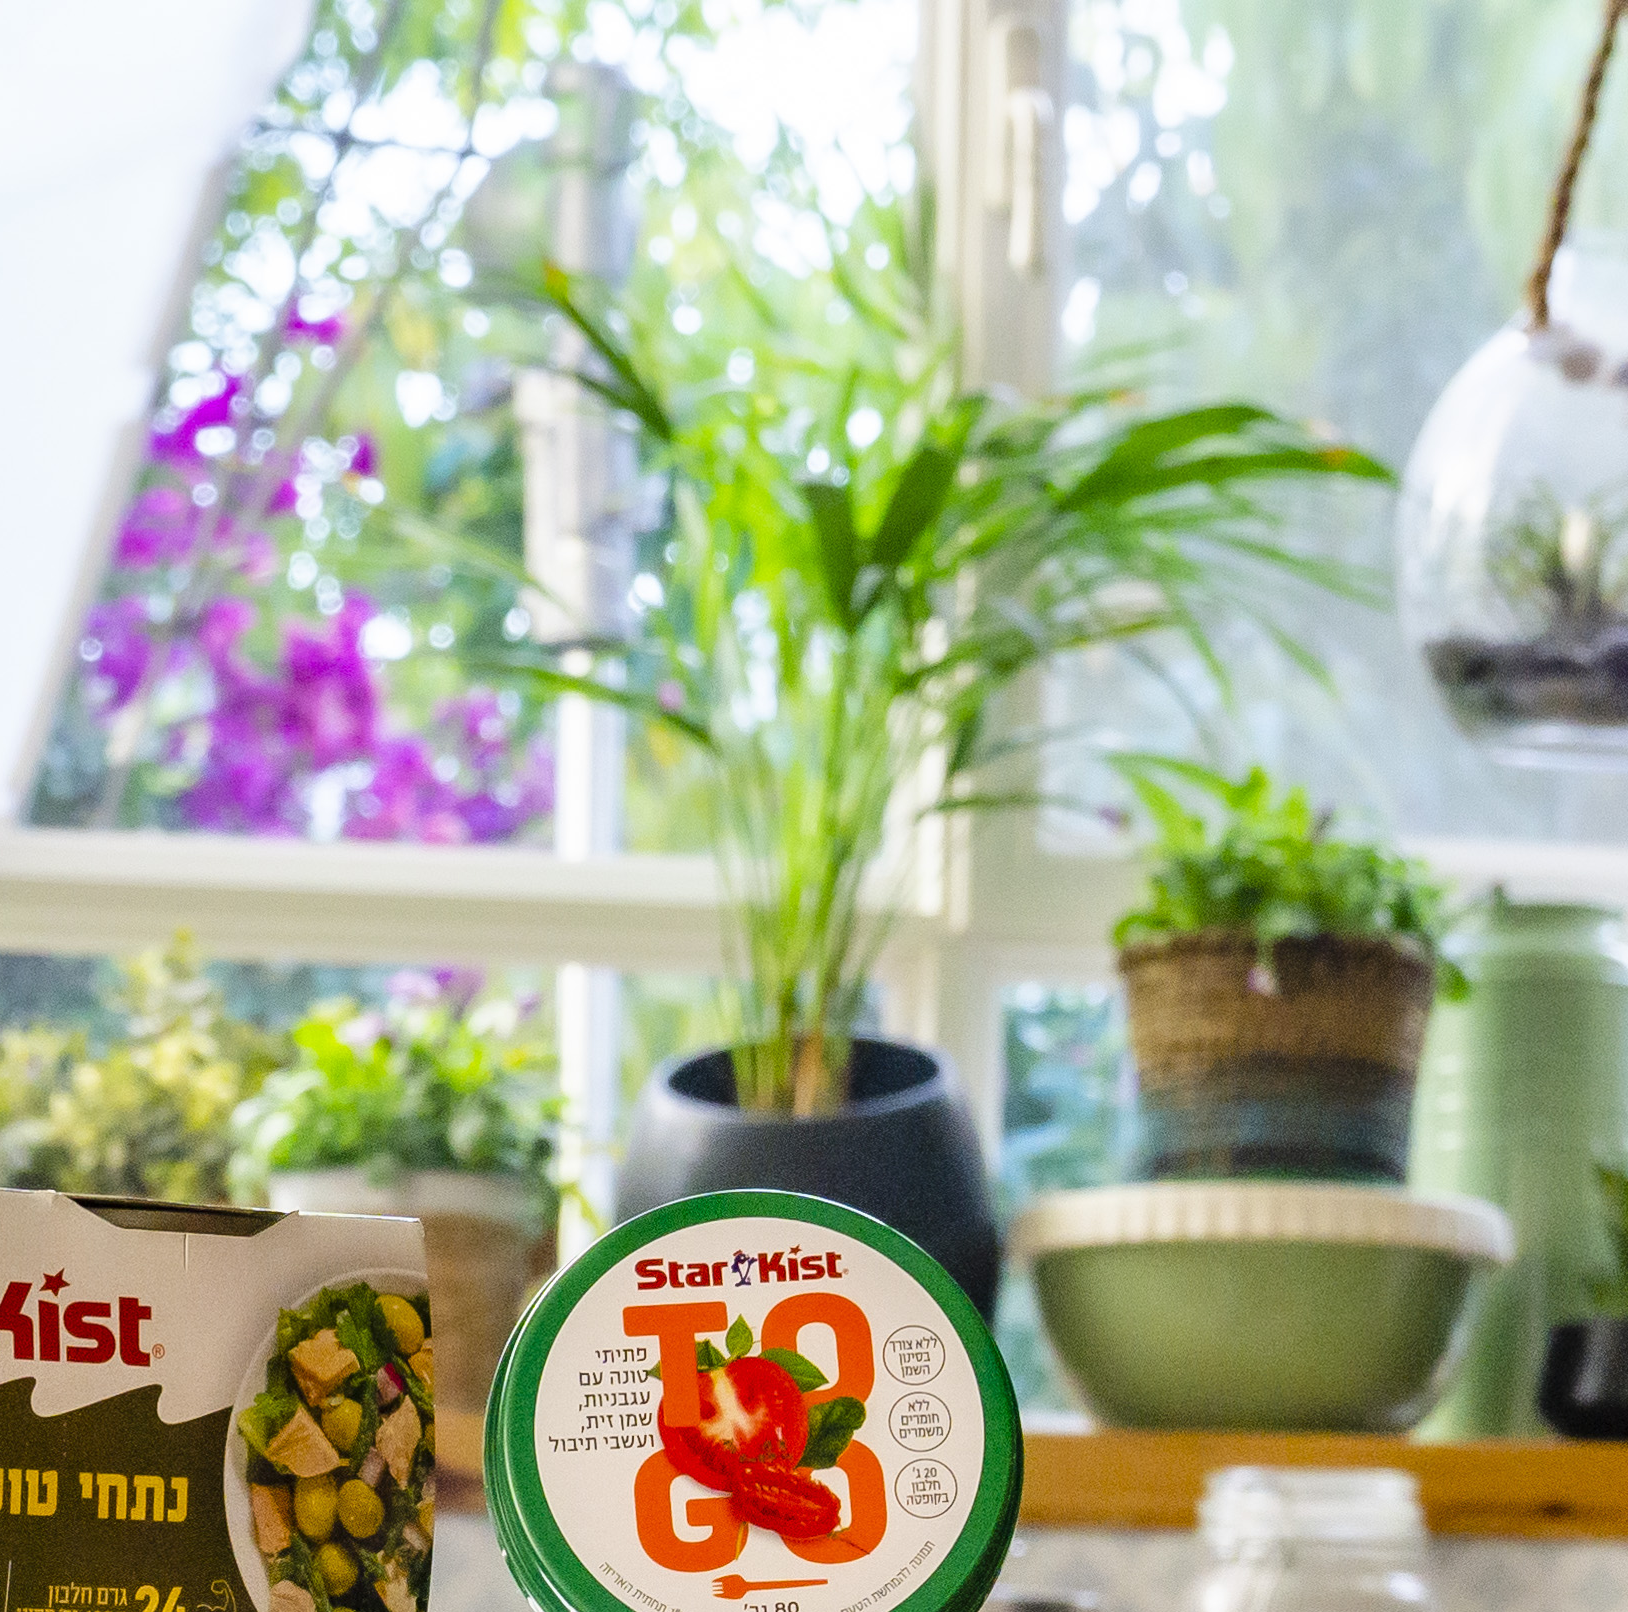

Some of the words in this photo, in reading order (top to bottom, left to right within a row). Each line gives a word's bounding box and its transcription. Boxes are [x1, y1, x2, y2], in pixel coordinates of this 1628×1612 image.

[889, 1340, 912, 1353] צורך
[916, 1336, 937, 1349] ללא
[595, 1348, 646, 1363] פתיתי
[899, 1351, 930, 1365] בסינון
[610, 1370, 649, 1385] טונה
[901, 1365, 930, 1378] השמן
[579, 1372, 603, 1386] עם
[579, 1391, 650, 1411] עגבניות,
[908, 1400, 930, 1412] ללא
[581, 1415, 613, 1433] זית,
[619, 1413, 652, 1431] שמן
[901, 1414, 939, 1426] חומרים
[899, 1427, 943, 1438] משמרים
[549, 1436, 597, 1452] תיבול
[603, 1434, 654, 1449] ועשבי
[913, 1467, 921, 1478] ג'
[924, 1467, 937, 1478] 20
[912, 1480, 941, 1494] חלבון
[79, 1472, 189, 1523] נתחי
[906, 1493, 949, 1505] בקופסה
[909, 1540, 936, 1569] תמונה
[599, 1562, 634, 1593] האריזה
[49, 1582, 92, 1608] חלבון
[96, 1589, 128, 1606] גרם
